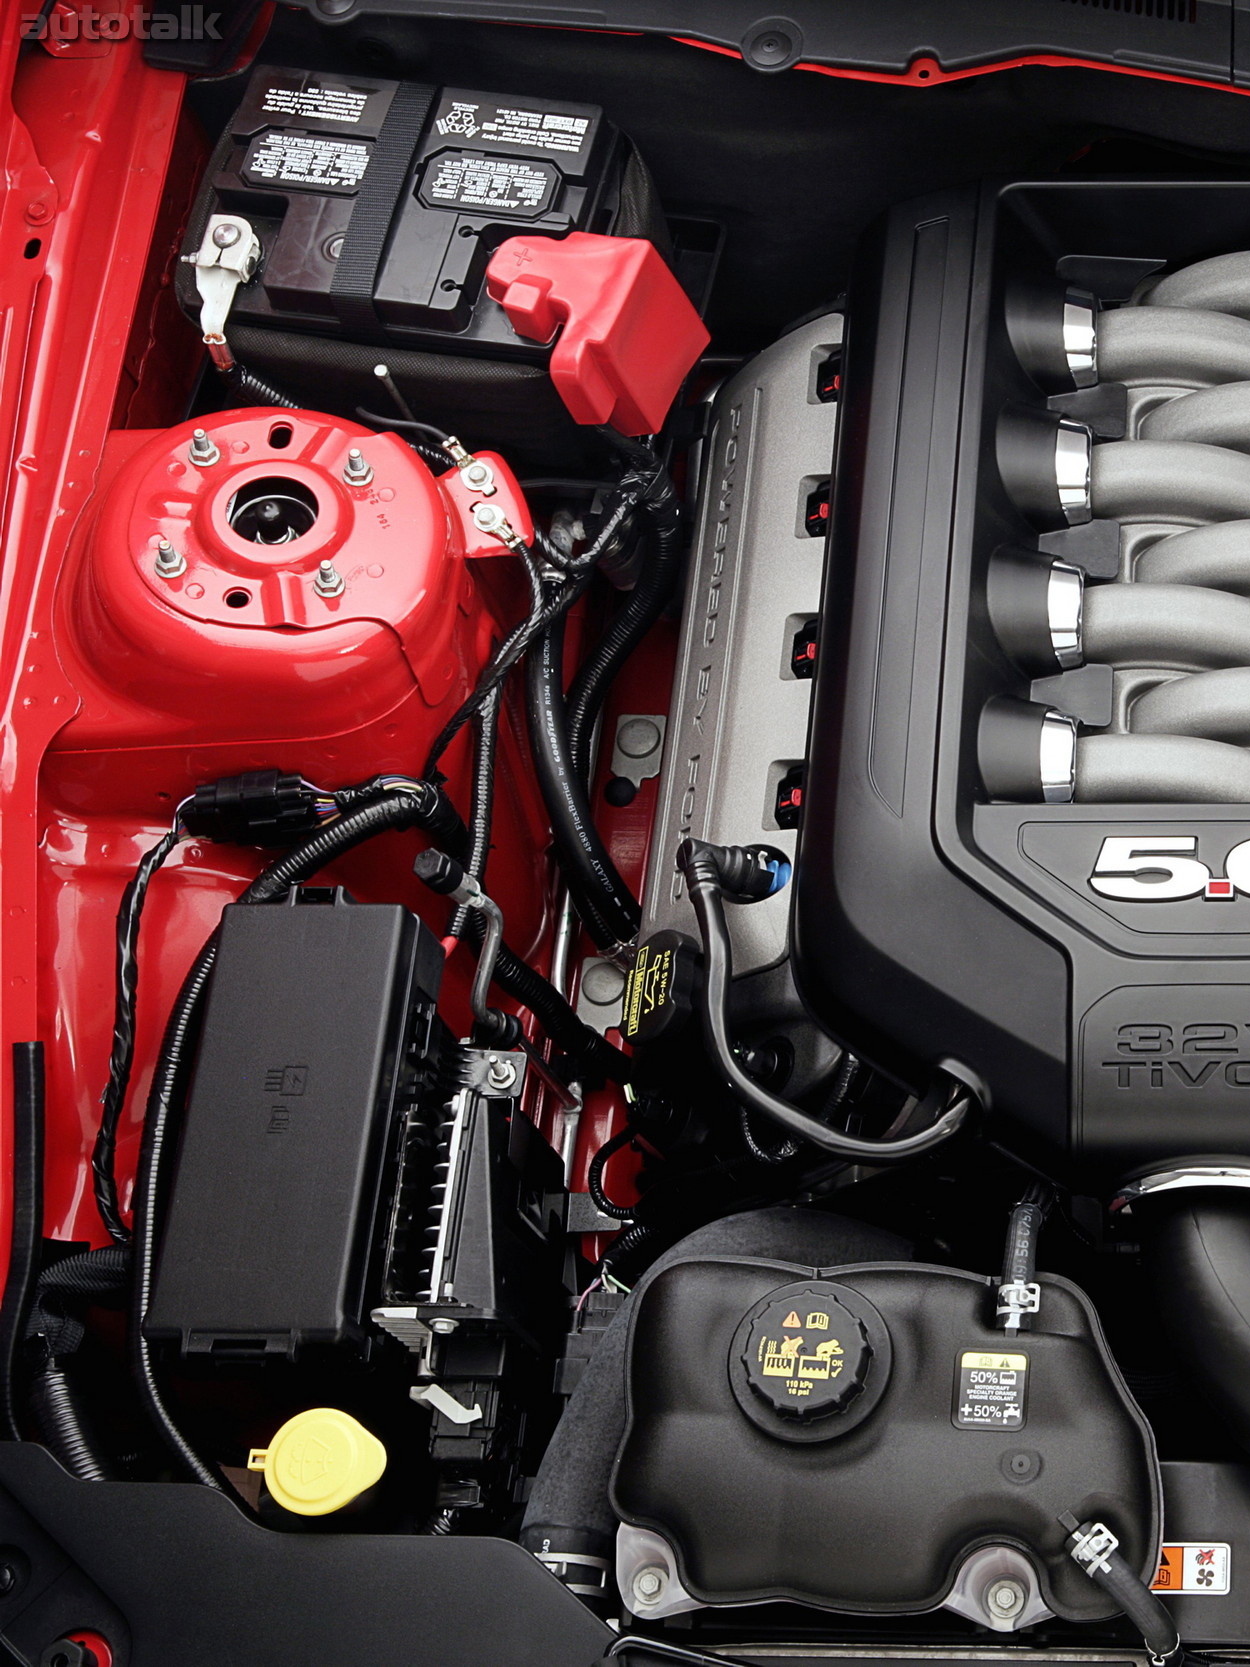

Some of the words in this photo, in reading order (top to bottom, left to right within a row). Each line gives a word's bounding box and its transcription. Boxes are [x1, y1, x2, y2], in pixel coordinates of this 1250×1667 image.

[542, 122, 586, 134] Motorcraft
[460, 194, 510, 207] DANGER/POISON
[703, 409, 740, 648] POWERED
[693, 667, 711, 734] BY
[547, 710, 560, 762] GOODYEAR
[558, 767, 565, 776] by
[561, 781, 583, 830] FlexBarrier
[581, 830, 593, 852] 4880
[590, 858, 614, 893] GALAXY
[662, 950, 671, 970] SAE
[623, 970, 634, 1021] Recommended
[629, 971, 645, 1033] Motorcraft
[658, 972, 669, 1006] 5W-20
[786, 1380, 798, 1388] 110
[800, 1381, 813, 1389] kPa
[970, 1371, 998, 1384] 50%
[798, 1389, 810, 1397] psi
